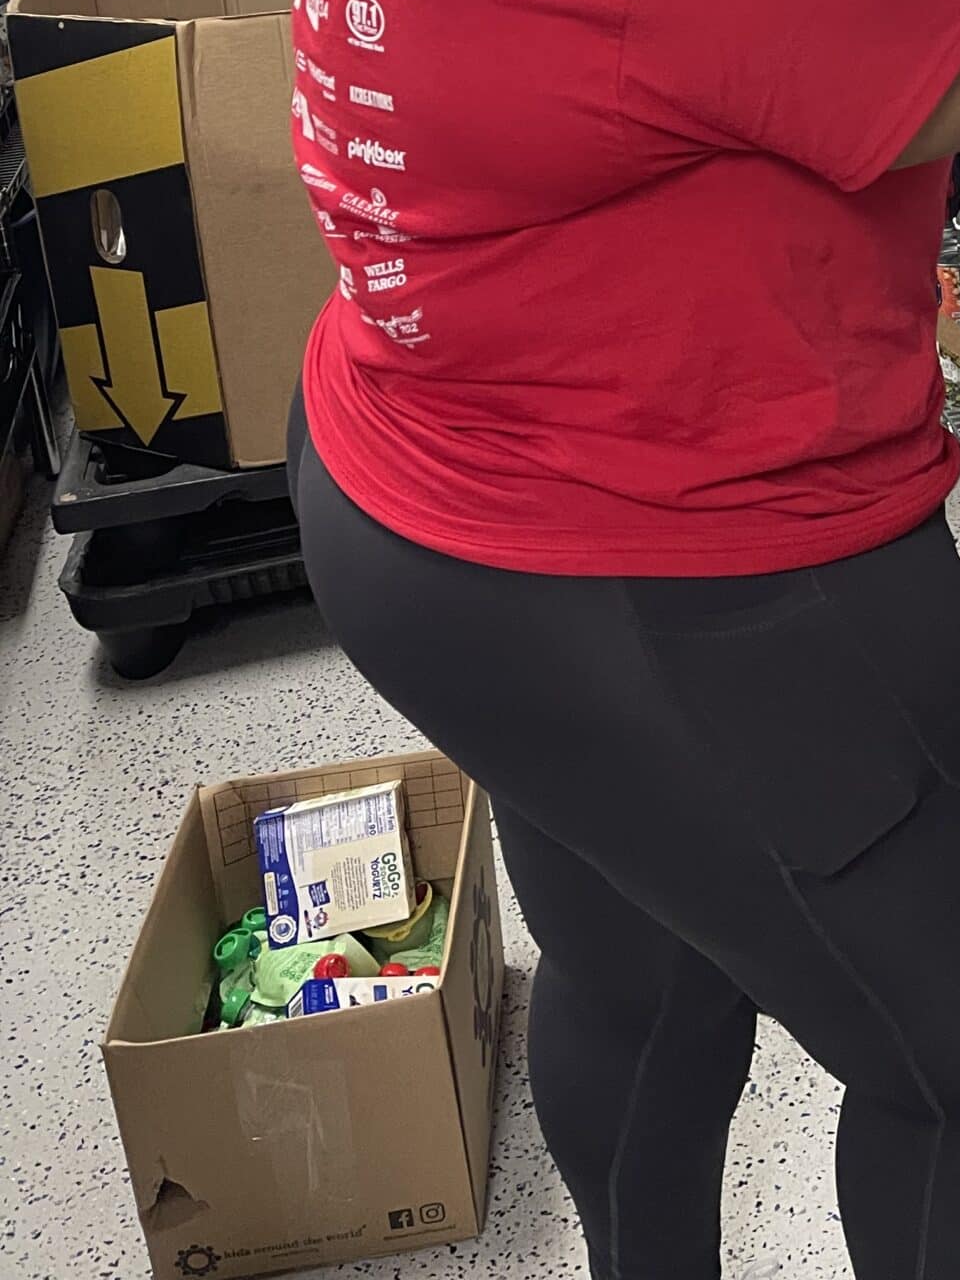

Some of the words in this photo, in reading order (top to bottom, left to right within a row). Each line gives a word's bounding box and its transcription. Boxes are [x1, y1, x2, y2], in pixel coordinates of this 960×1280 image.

[351, 0, 378, 28] 97.1
[347, 137, 406, 168] pinkbox
[342, 192, 400, 221] CAESARS
[364, 258, 405, 277] WELLS
[367, 274, 407, 292] FARGO
[371, 856, 383, 900] YOGURTZ
[381, 852, 400, 891] GoGo
[224, 1247, 250, 1260] kids
[254, 1240, 299, 1256] around
[303, 1235, 323, 1247] the
[326, 1228, 363, 1243] world
